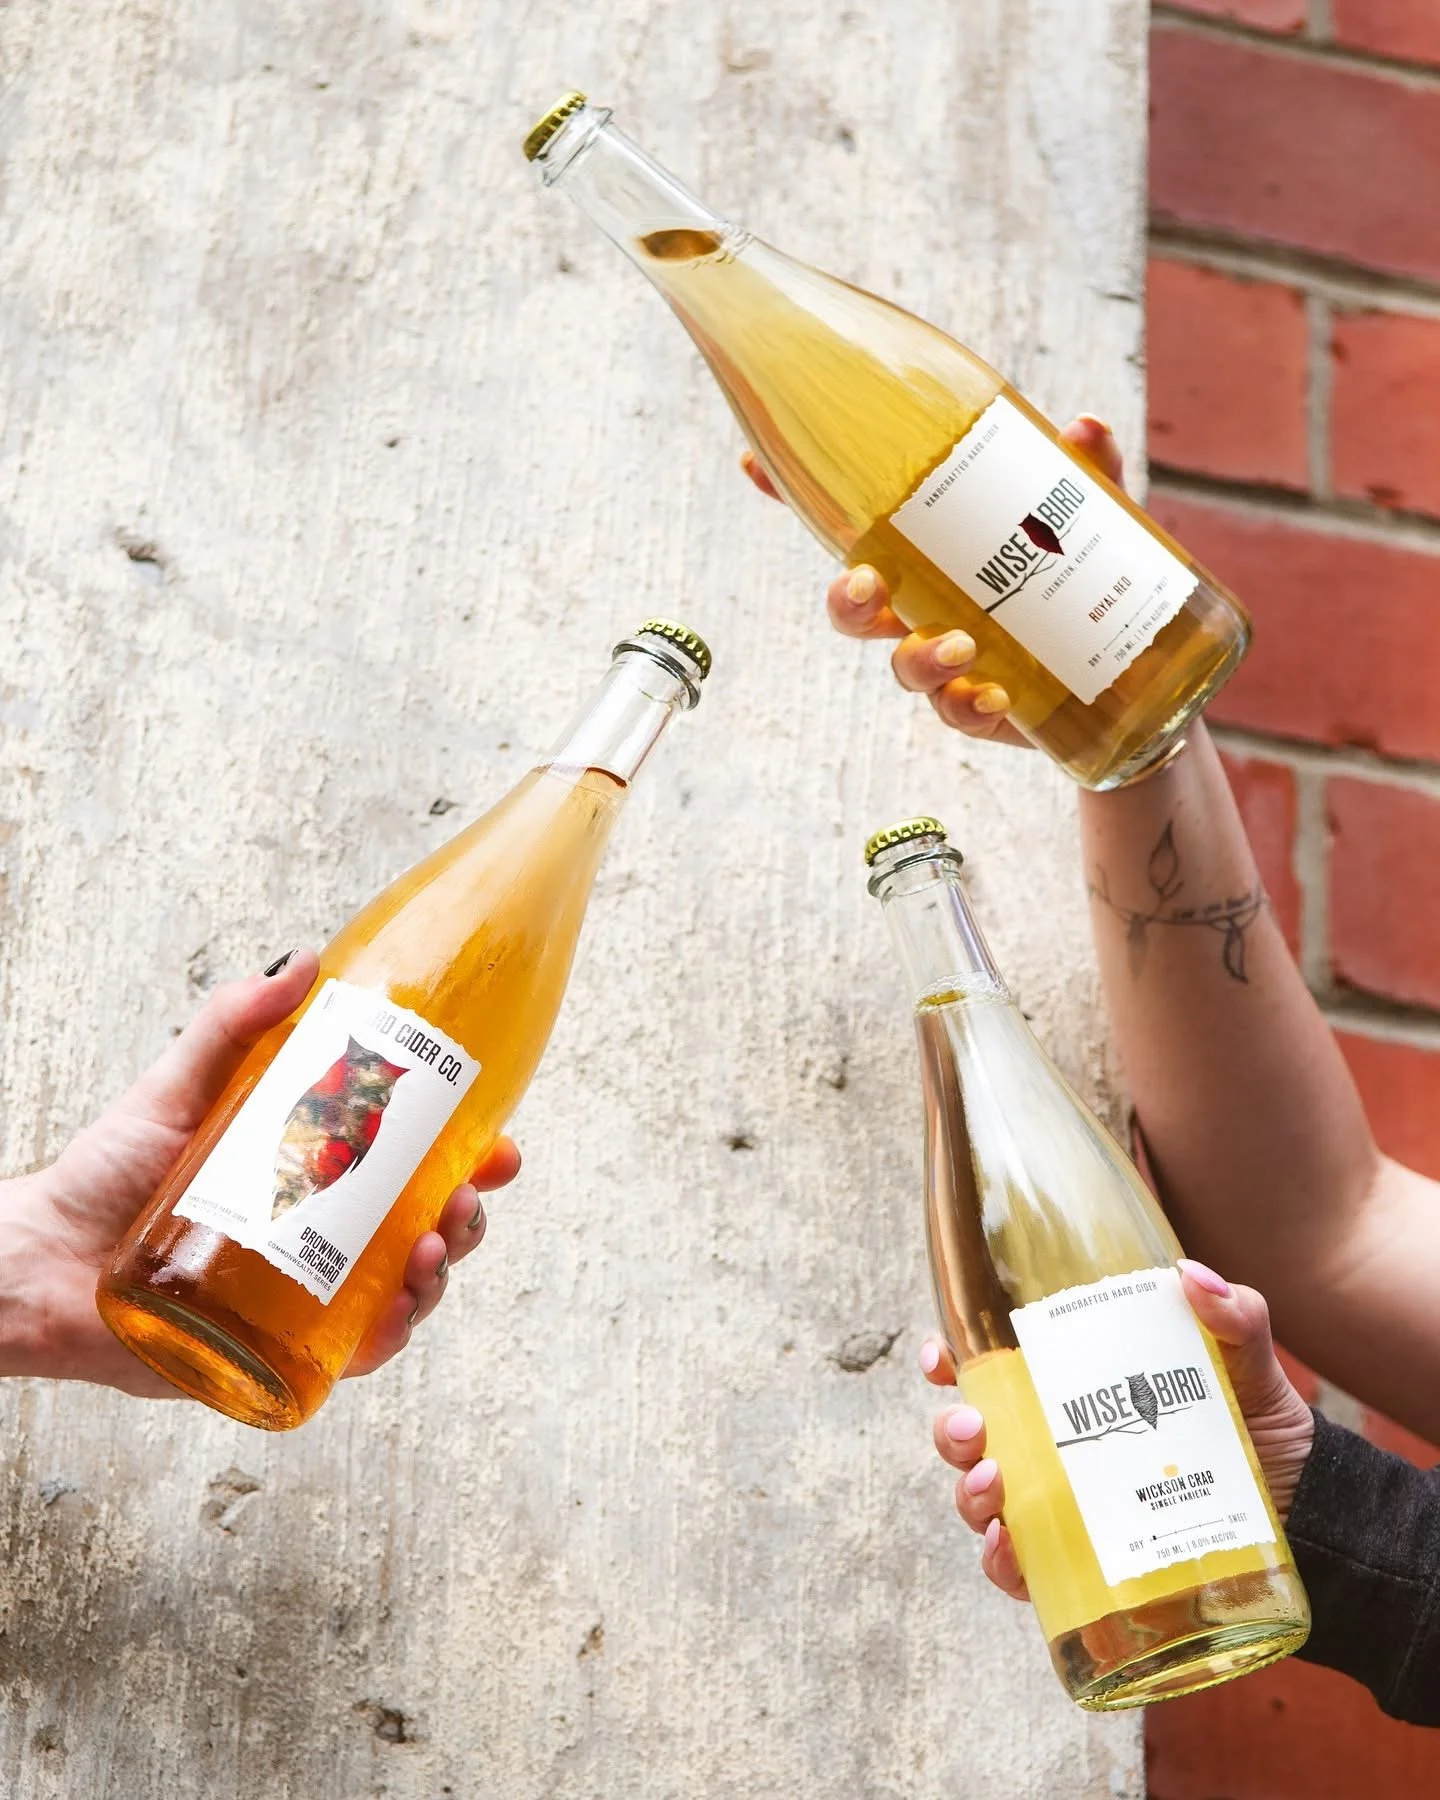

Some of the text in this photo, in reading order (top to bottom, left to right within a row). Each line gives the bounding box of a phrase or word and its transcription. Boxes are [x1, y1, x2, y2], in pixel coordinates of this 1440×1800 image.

[923, 460, 968, 507] HANDCRAFTED
[967, 442, 984, 461] HARD
[975, 532, 1038, 595] WISE
[1036, 477, 1085, 530] BIRD
[1075, 533, 1101, 563] KENTUCKY
[1088, 576, 1131, 623] ROYAL RED
[1087, 652, 1102, 667] DRY
[1113, 648, 1127, 662] 750
[394, 1023, 442, 1065] CIDER
[437, 1054, 462, 1086] CO.
[267, 1240, 331, 1291] COMMONWEALTH SERIES
[298, 1245, 341, 1283] ORCHARD
[300, 1226, 348, 1271] BROWNING
[1049, 1281, 1157, 1318] HANDCRAFTED HARD CIDER
[1062, 1366, 1206, 1435] WISE BIRD
[1136, 1470, 1214, 1502] WICKSON CRAB
[1150, 1487, 1211, 1510] SINGLE VARIETAL
[1129, 1512, 1247, 1552] DRY SWEET
[1155, 1547, 1170, 1559] 750
[1211, 1530, 1237, 1543] ALC/VOL
